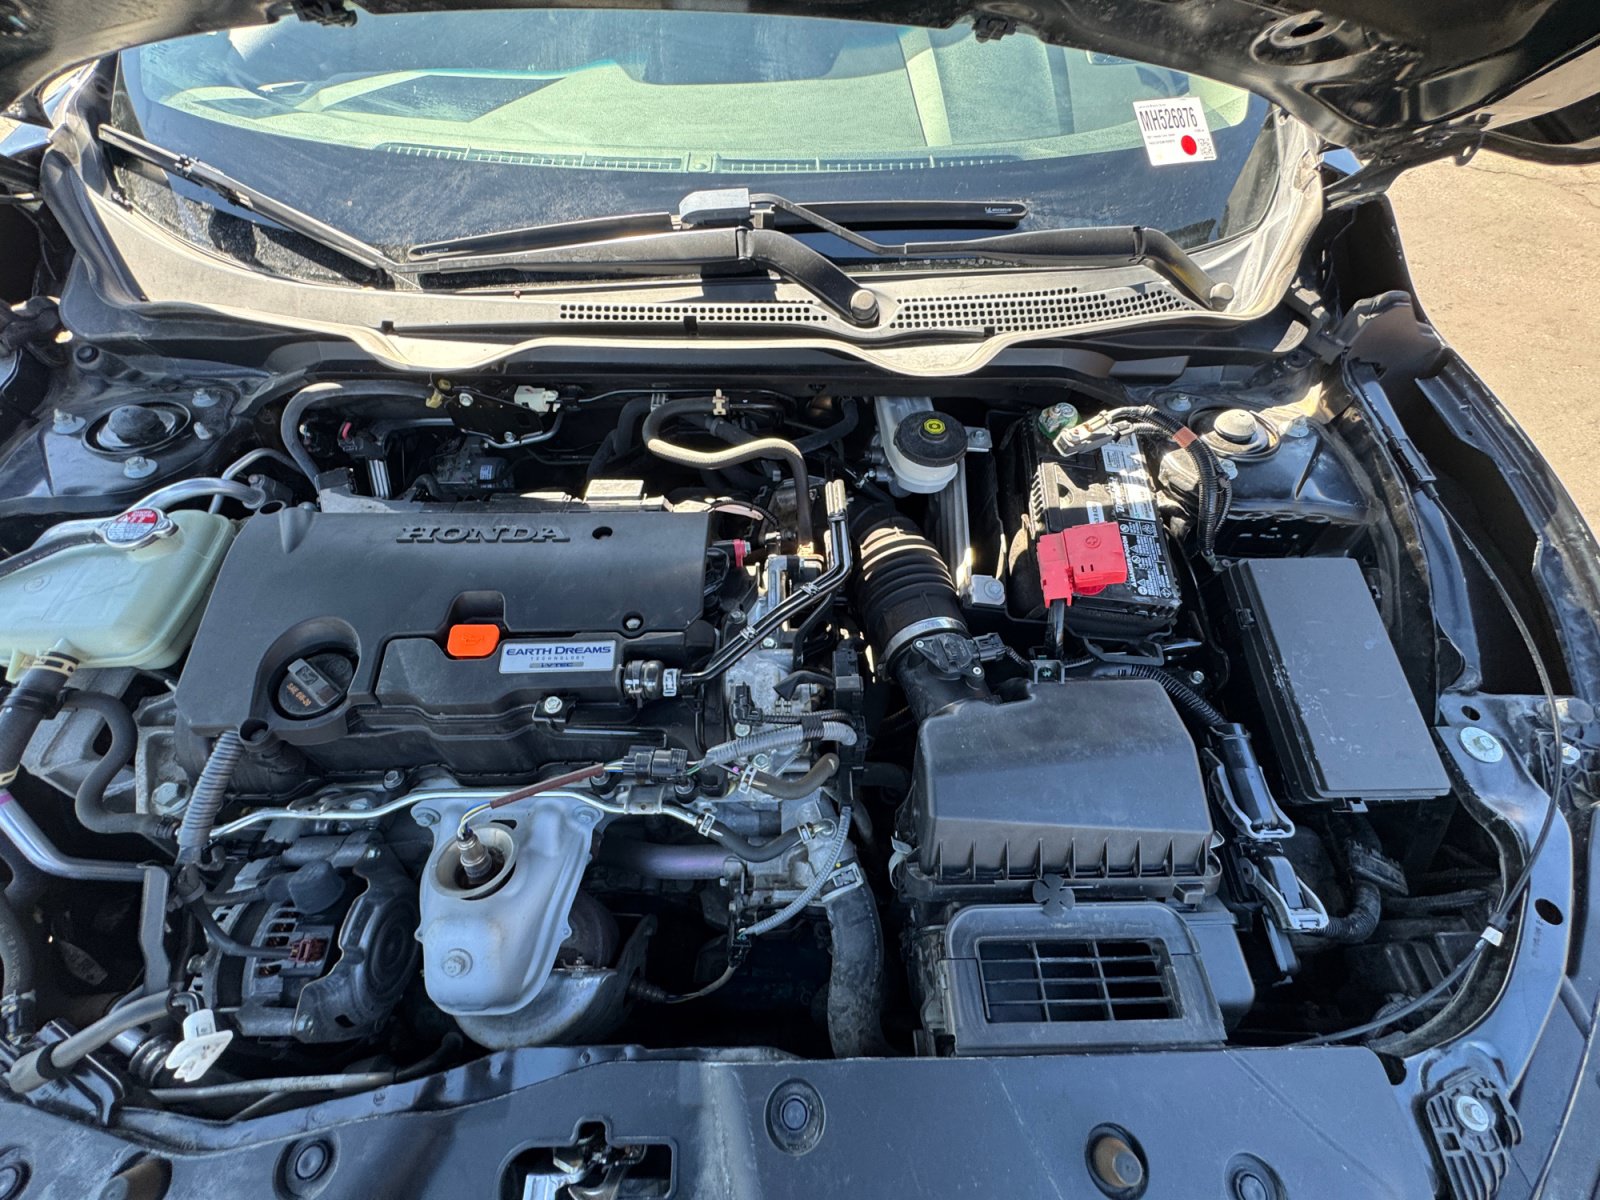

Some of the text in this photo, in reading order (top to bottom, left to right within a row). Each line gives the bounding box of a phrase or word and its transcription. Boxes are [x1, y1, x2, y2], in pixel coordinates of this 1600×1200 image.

[1139, 107, 1198, 131] MH526876
[396, 525, 571, 543] HONDA
[506, 648, 552, 656] EARTH
